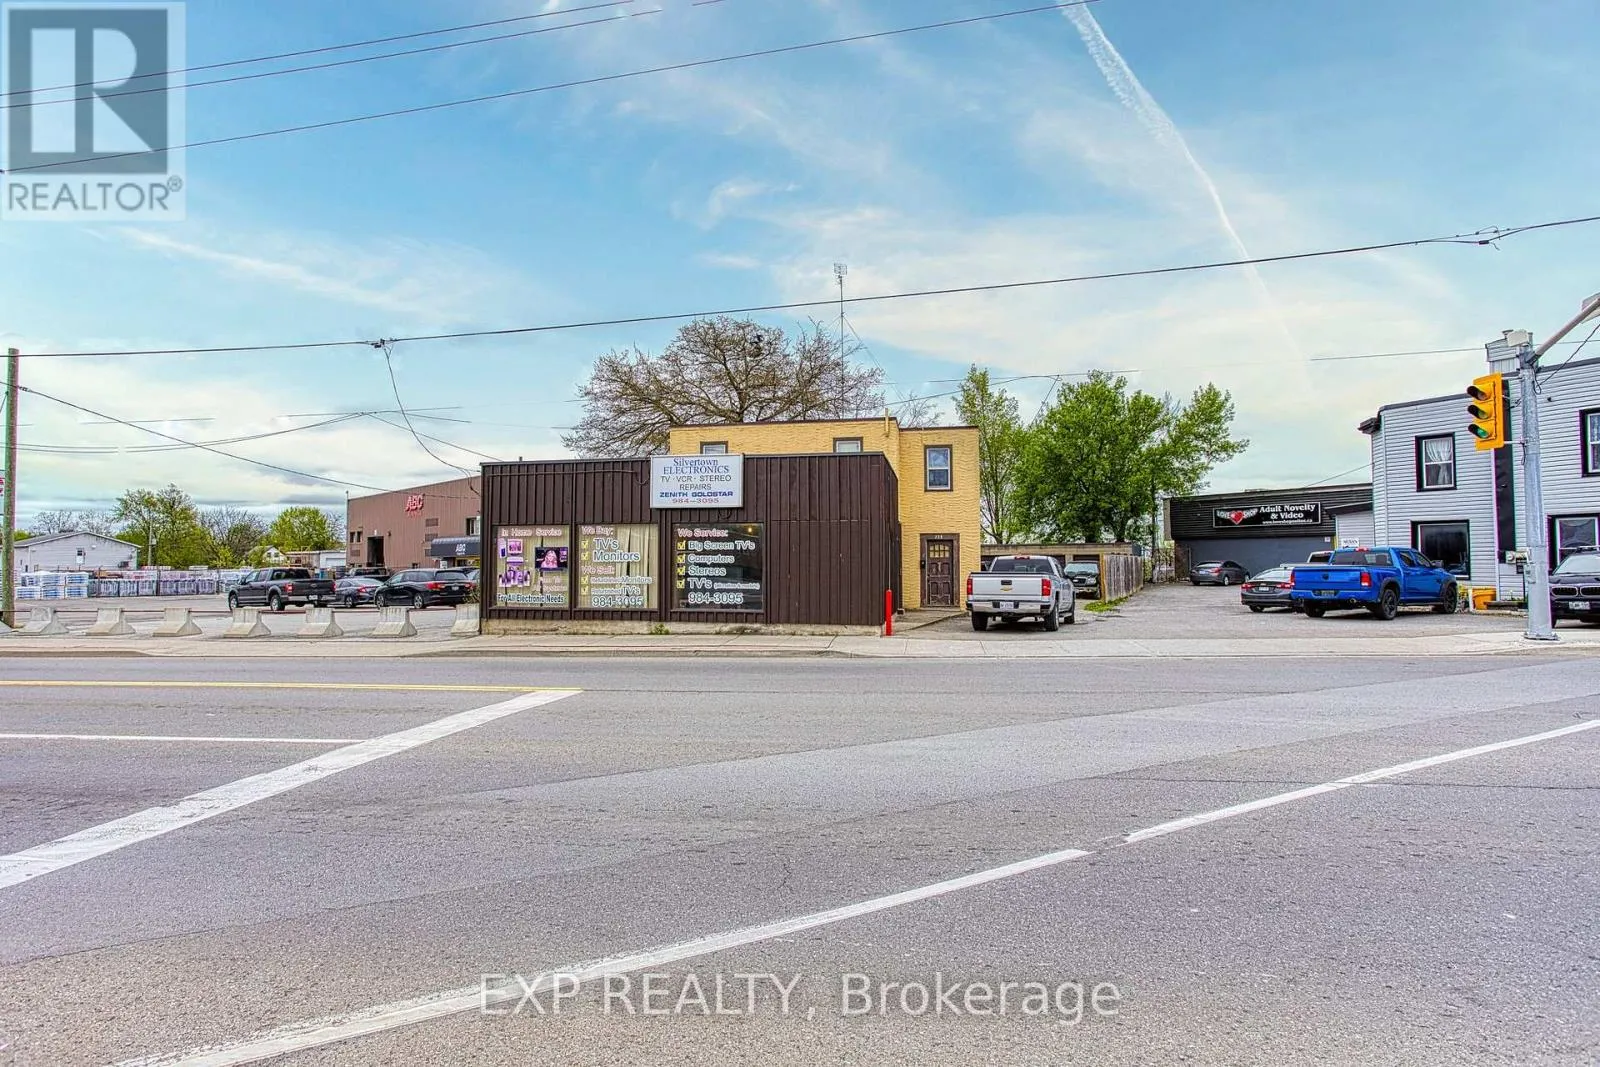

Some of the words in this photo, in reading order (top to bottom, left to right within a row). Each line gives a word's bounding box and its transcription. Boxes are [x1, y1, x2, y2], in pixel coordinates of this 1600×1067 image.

[673, 457, 718, 467] Silvertown
[663, 465, 730, 475] ELECTRONICS
[660, 475, 670, 483] TV
[676, 475, 692, 483] VCR
[699, 474, 732, 482] STEREO
[679, 483, 712, 491] REPAIRS
[1260, 505, 1282, 513] Adult
[1283, 503, 1316, 512] Novelty
[535, 528, 563, 537] Service
[677, 528, 693, 537] We
[694, 528, 729, 537] Service:
[593, 538, 619, 550] TV's
[688, 541, 703, 551] Big
[704, 541, 734, 550] Screen
[735, 541, 756, 550] TV's
[593, 551, 640, 562] Monitors
[688, 554, 735, 565] Computers
[688, 565, 727, 576] Stereos
[622, 576, 652, 584] Monitors
[687, 578, 712, 588] TV's
[516, 594, 546, 603] Electronic
[546, 594, 564, 602] Needs
[592, 596, 644, 607] 984-3095
[688, 592, 743, 604] 984-3095
